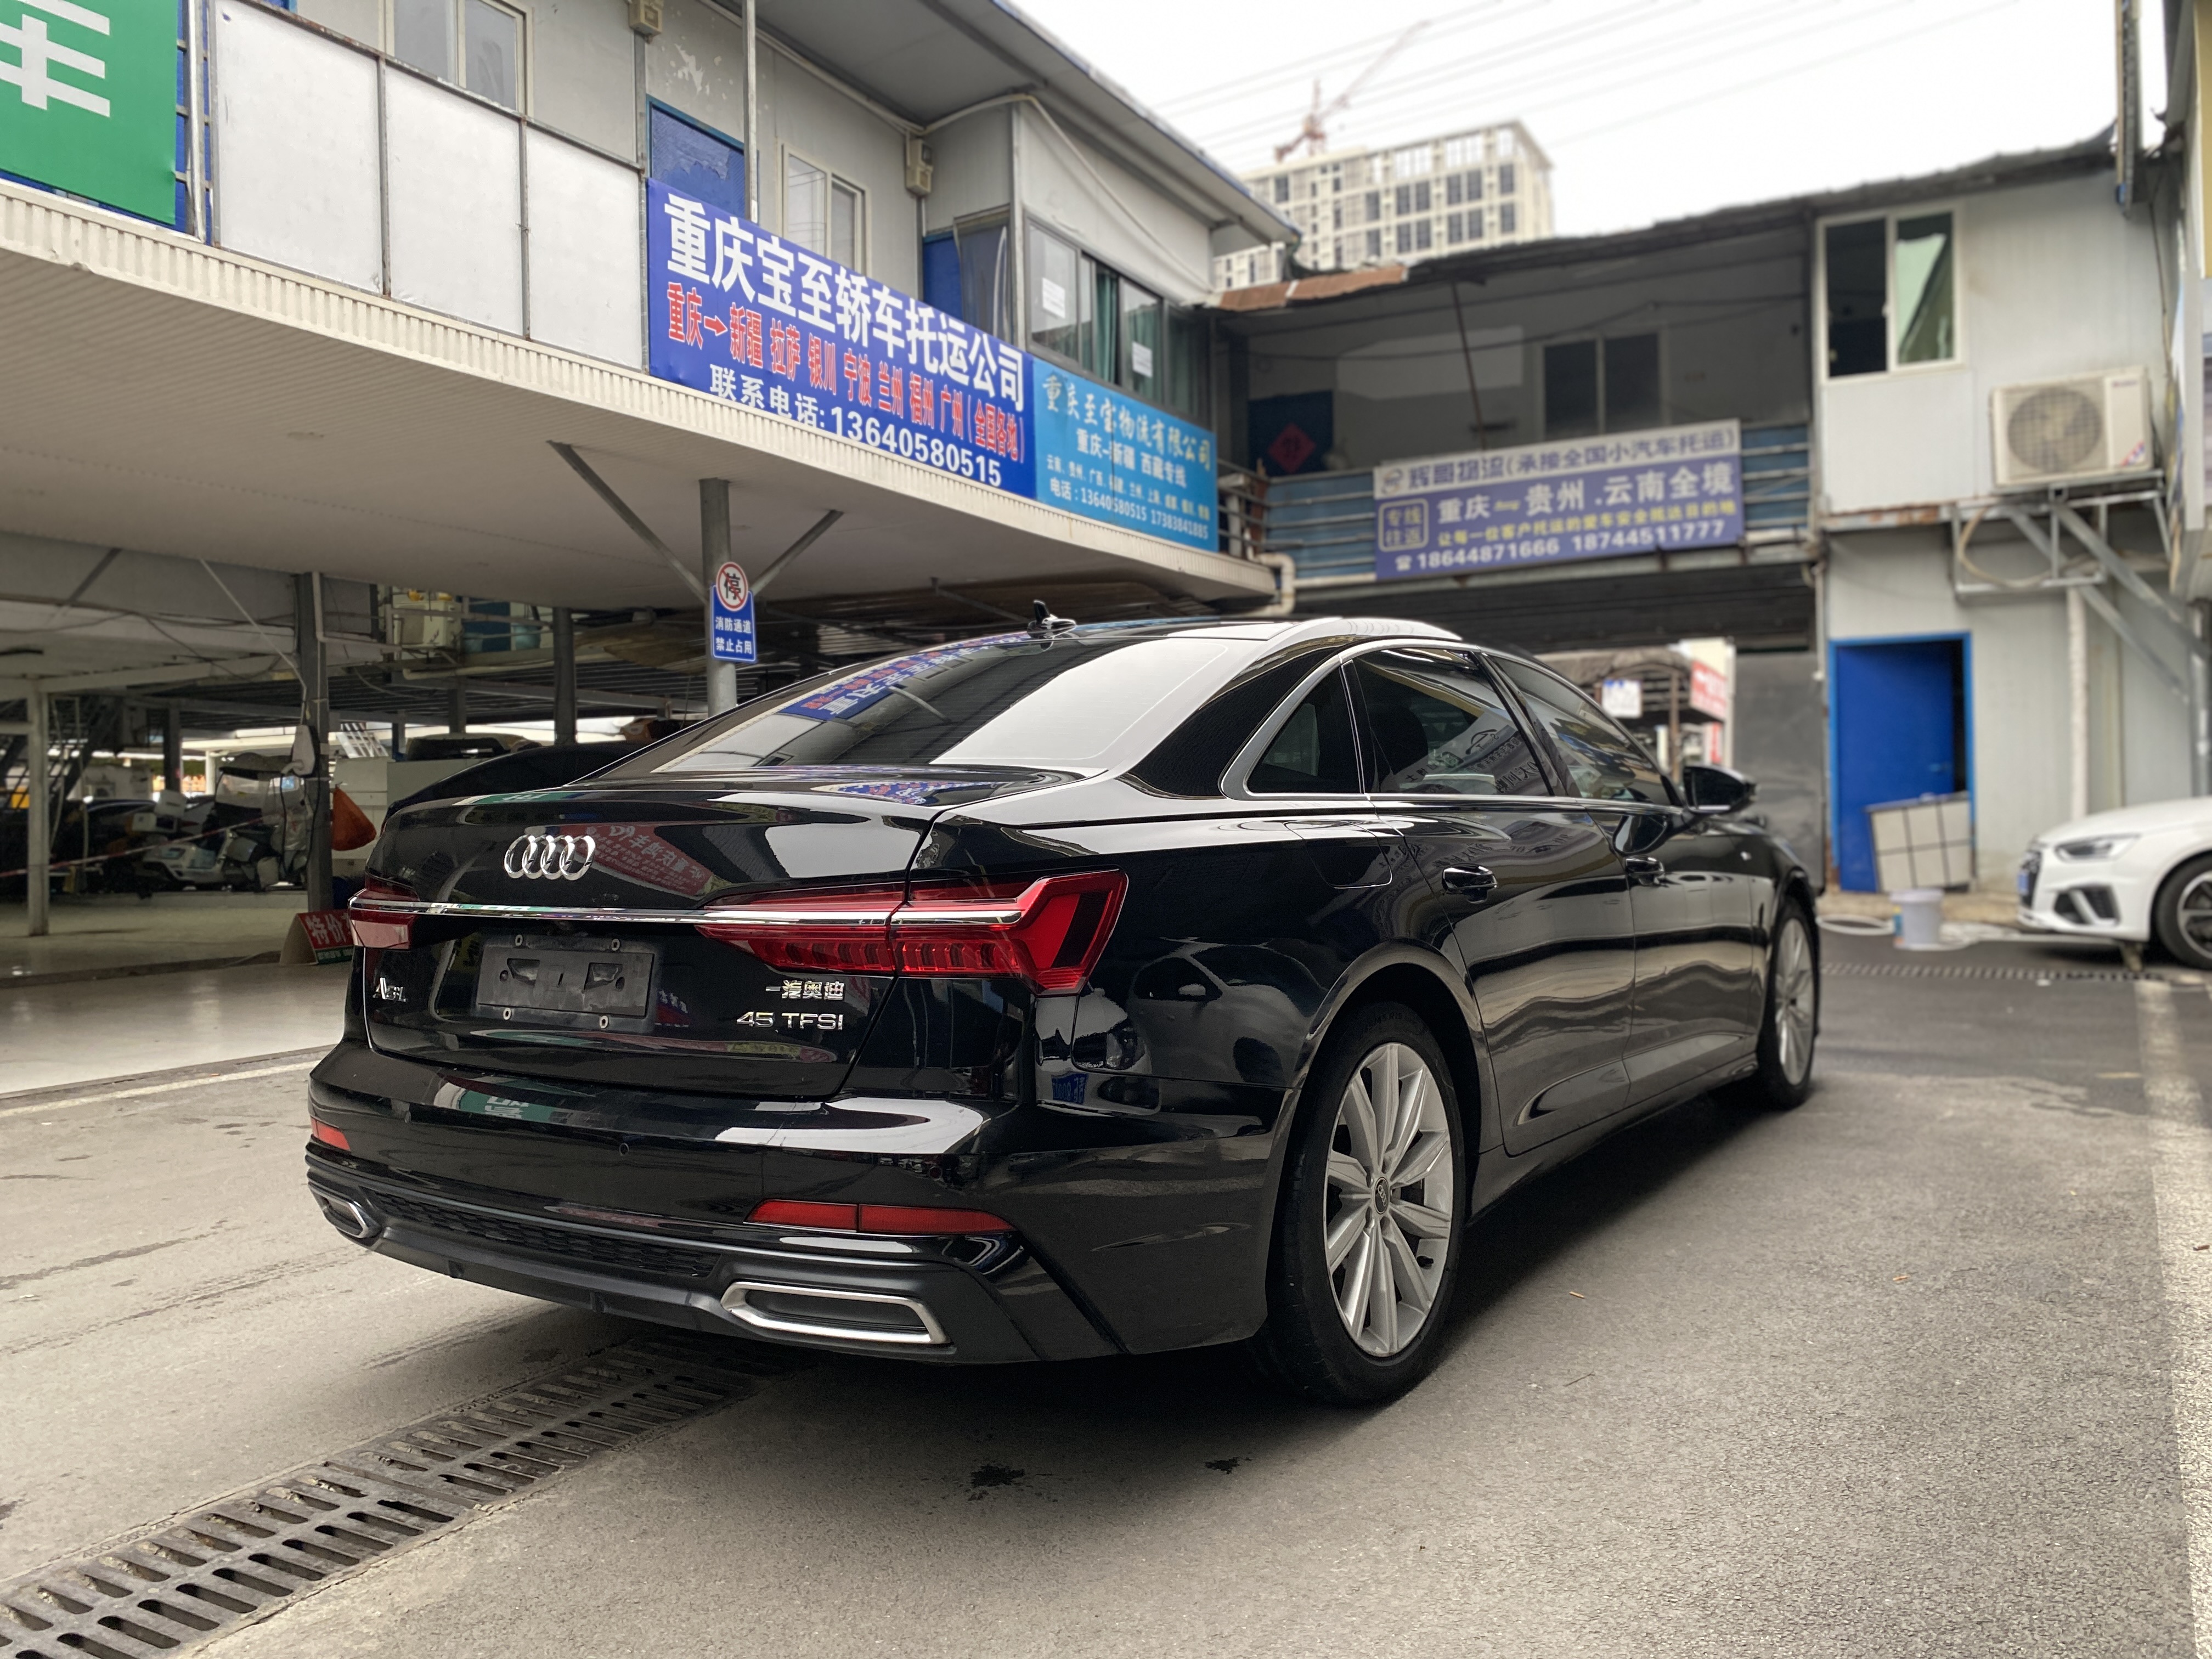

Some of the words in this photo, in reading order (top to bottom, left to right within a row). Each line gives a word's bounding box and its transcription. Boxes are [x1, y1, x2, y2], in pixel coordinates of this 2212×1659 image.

[664, 193, 1024, 412] 重庆宝至轿车托运公司
[668, 283, 703, 349] 重庆
[730, 303, 763, 369] 新疆
[770, 318, 800, 381] 拉萨
[808, 332, 837, 395] 银川
[844, 349, 872, 407] 宁波
[878, 363, 904, 419] 兰州
[909, 371, 933, 428] 福州
[940, 386, 963, 439] 广州
[1387, 507, 1421, 526] 专线
[1437, 496, 1491, 523] 重庆
[1417, 538, 1559, 568] 18644871666
[1573, 520, 1724, 551] 18744511777
[715, 616, 752, 634] 消防通道
[715, 636, 752, 654] 禁止占用
[765, 980, 844, 1000] 一汽奥迪
[736, 1011, 774, 1028] 45
[781, 1013, 844, 1030] TFSI
